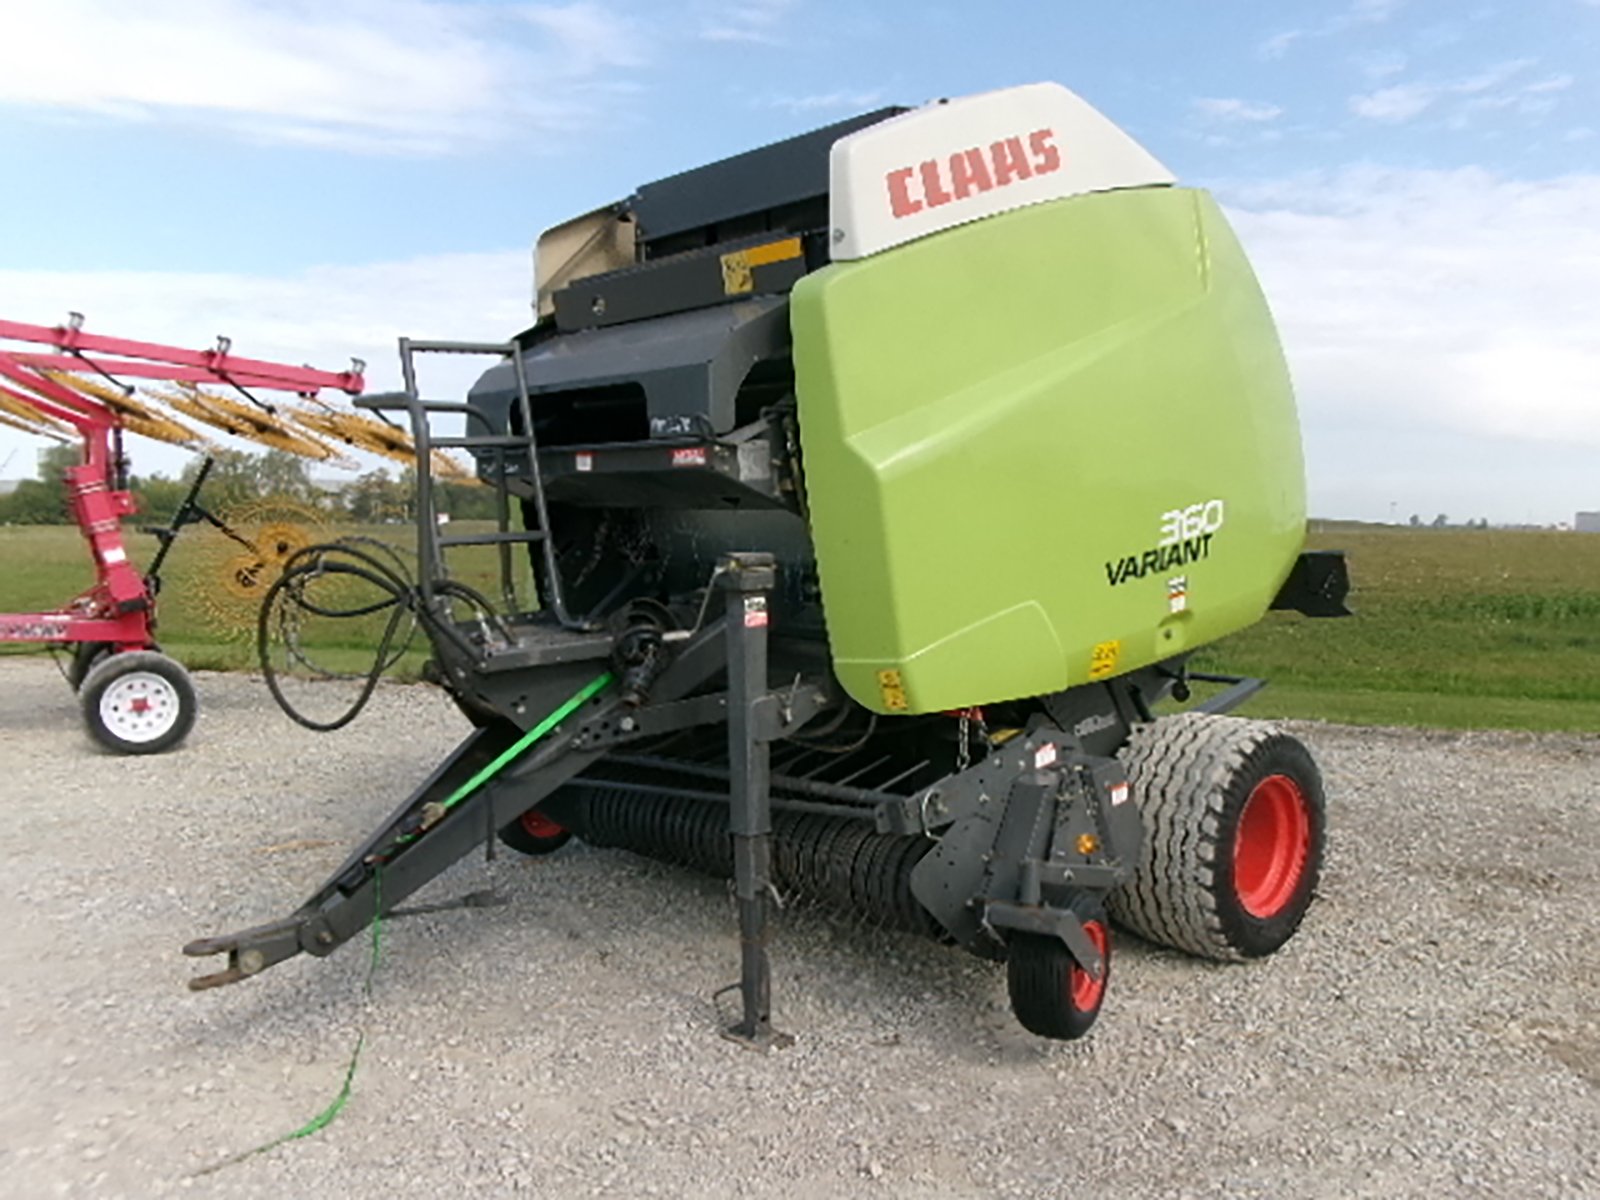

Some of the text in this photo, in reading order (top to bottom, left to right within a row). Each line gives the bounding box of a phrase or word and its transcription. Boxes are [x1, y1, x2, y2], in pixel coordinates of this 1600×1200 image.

[886, 128, 1061, 219] CLAAS
[1158, 499, 1224, 546] 360
[1105, 533, 1213, 586] VARIANT
